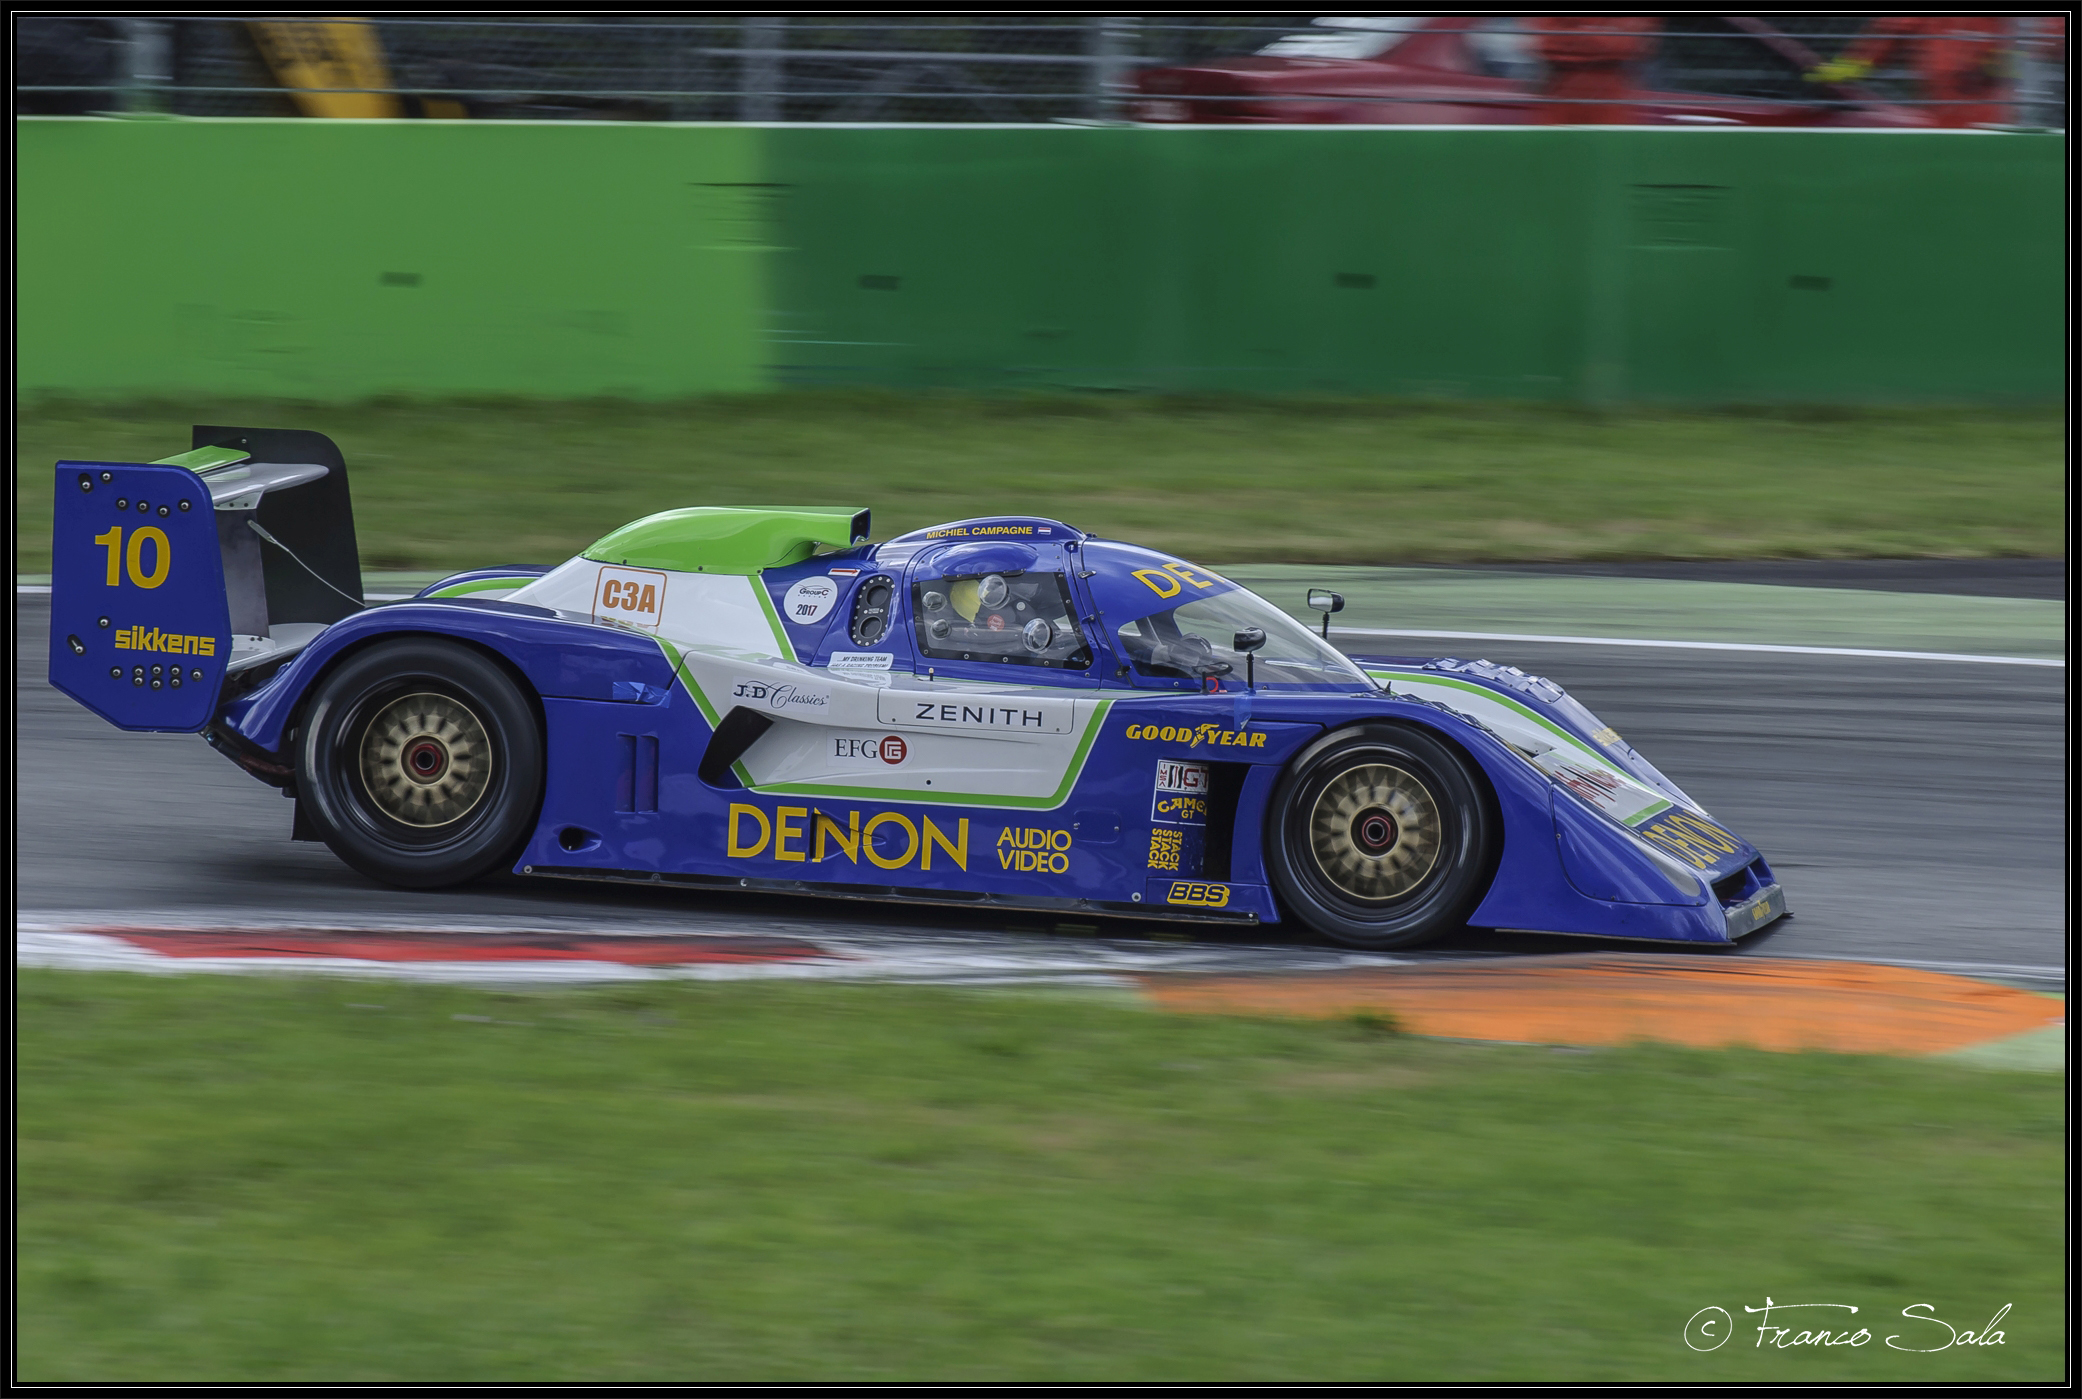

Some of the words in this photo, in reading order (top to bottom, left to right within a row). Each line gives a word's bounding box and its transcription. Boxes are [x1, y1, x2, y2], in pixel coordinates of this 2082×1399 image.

[926, 528, 969, 539] MICHIEL
[971, 526, 1033, 536] CAMPAGNE
[95, 526, 171, 589] 10
[602, 579, 656, 614] C3A
[795, 603, 818, 616] 2017
[115, 625, 215, 656] sikkens
[915, 702, 1043, 728] ZENITH
[834, 738, 878, 759] EFG
[1181, 809, 1195, 819] GT
[727, 803, 969, 873] DENON
[996, 826, 1073, 851] AUDIO
[1147, 827, 1163, 869] STACK
[1157, 829, 1173, 871] STACK
[1168, 830, 1183, 872] STACK
[1642, 809, 1742, 870] DENON
[996, 848, 1070, 875] VIDEO
[1167, 881, 1231, 908] BBS
